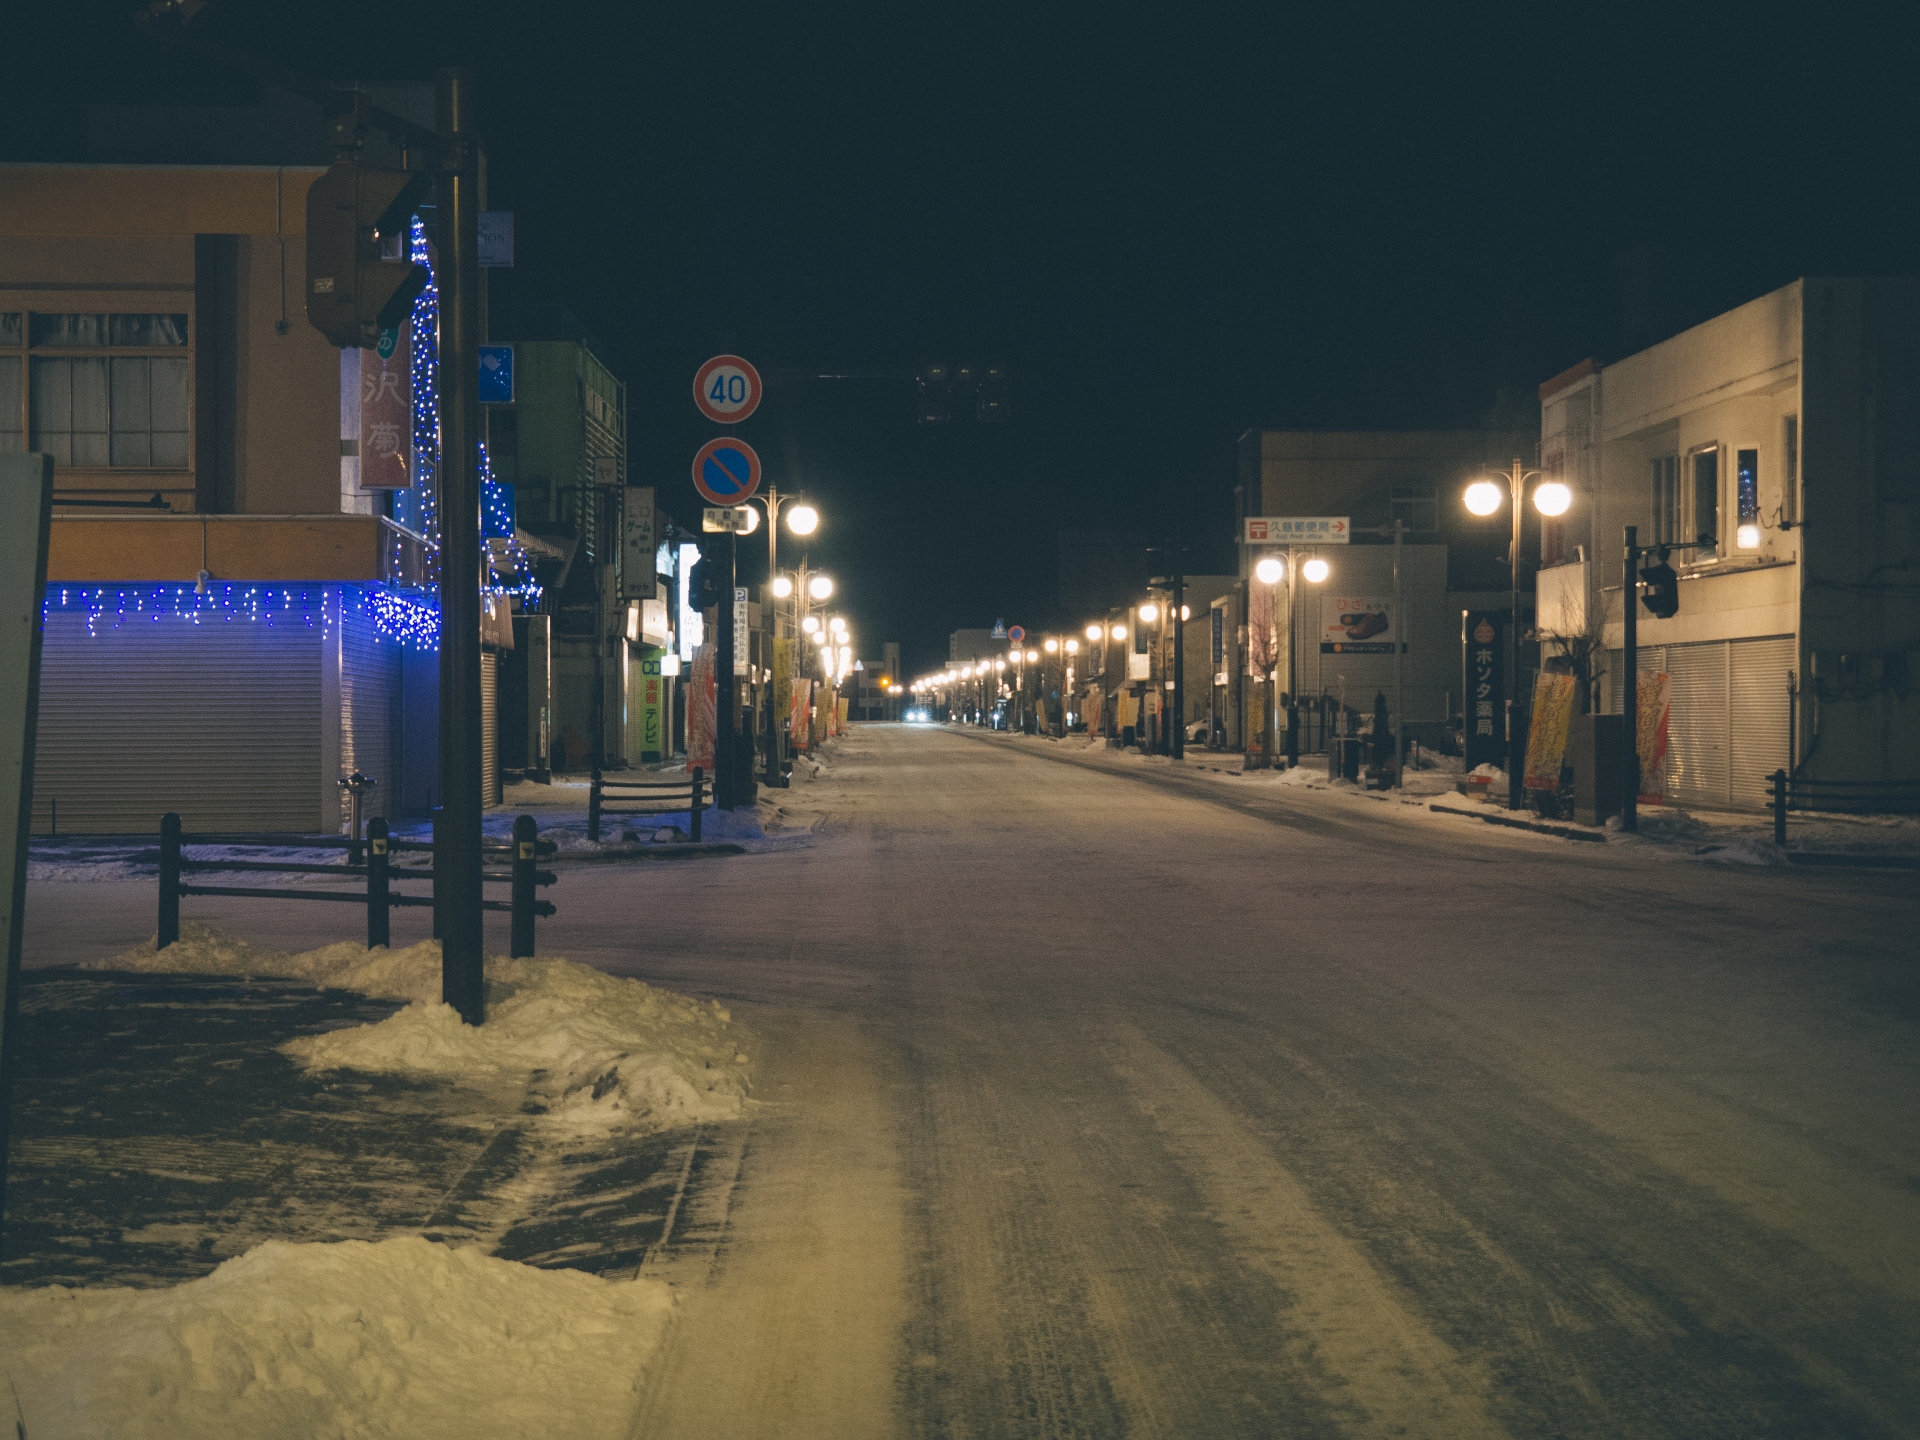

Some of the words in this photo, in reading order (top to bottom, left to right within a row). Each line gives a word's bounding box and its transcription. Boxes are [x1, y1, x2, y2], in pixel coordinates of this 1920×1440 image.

[710, 375, 746, 403] 40
[627, 521, 651, 533] ゲーム
[1270, 521, 1330, 532] 久慈郵便局
[642, 660, 661, 675] CD
[645, 679, 658, 704] 楽器
